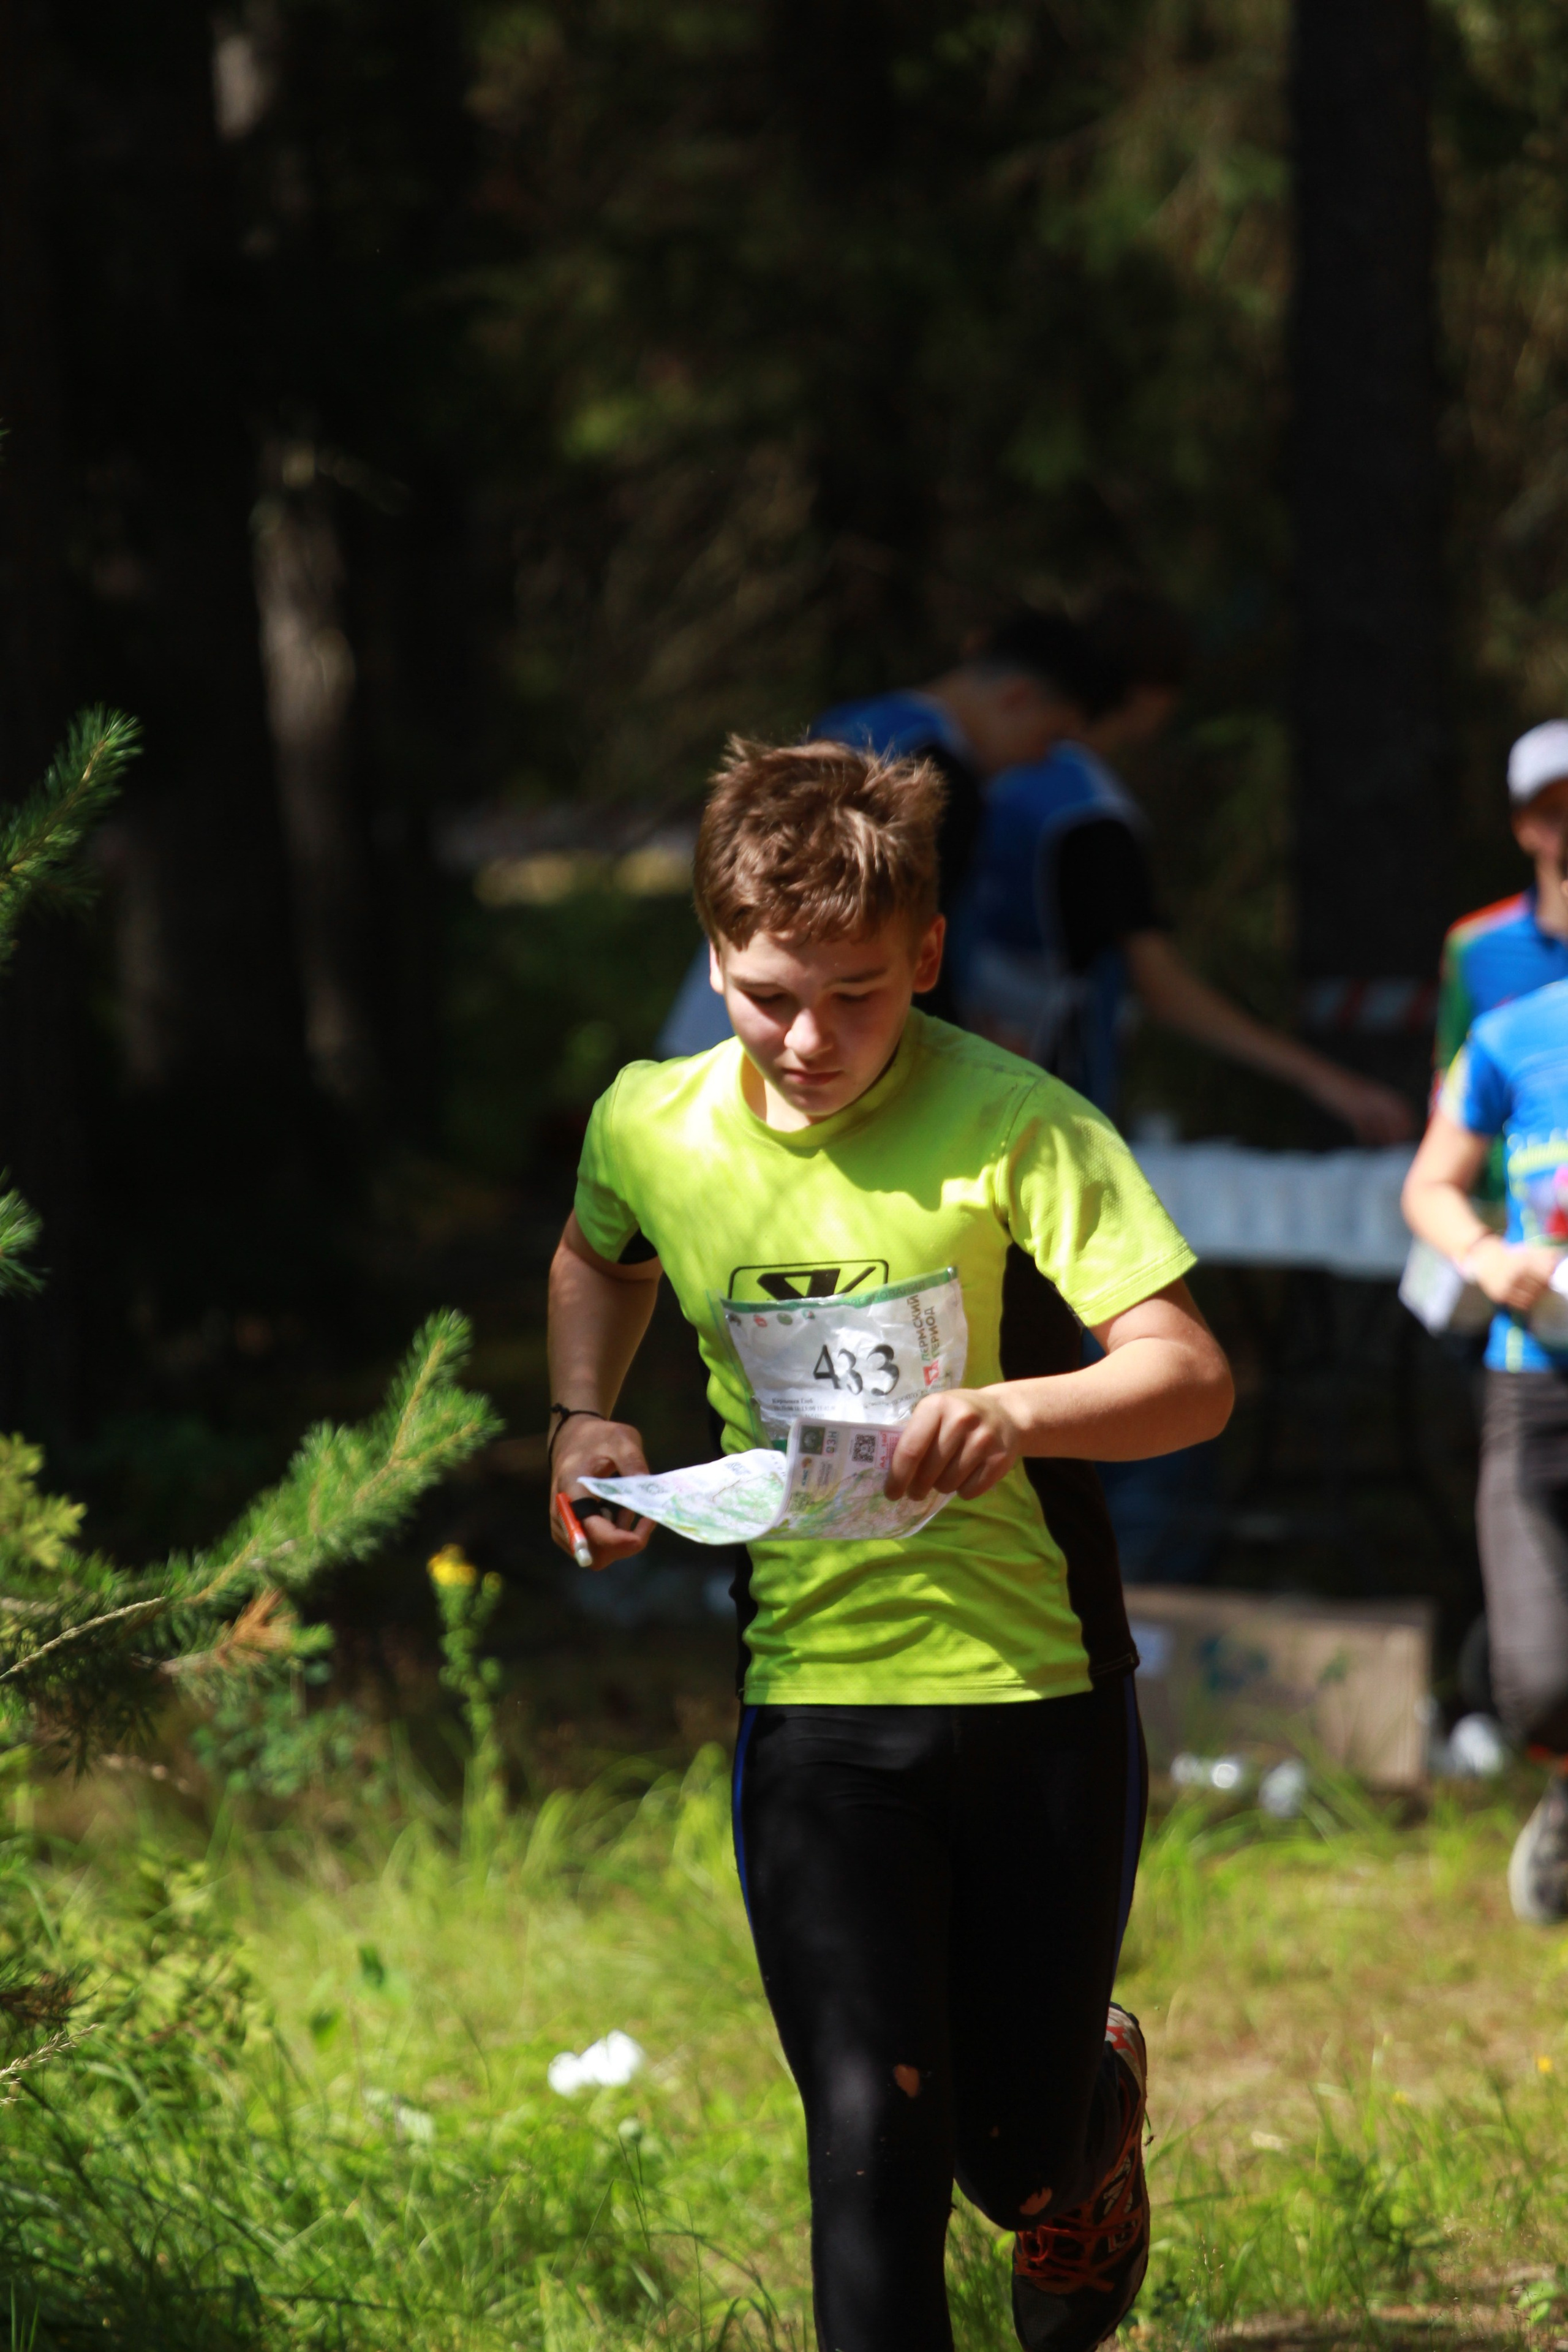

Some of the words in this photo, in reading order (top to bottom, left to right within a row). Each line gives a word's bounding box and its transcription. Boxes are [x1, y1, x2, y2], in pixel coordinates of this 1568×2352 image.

[907, 1294, 930, 1361] ПЕРМСКИЙ
[924, 1306, 940, 1358] ПЕРИОД
[813, 1344, 900, 1396] 433
